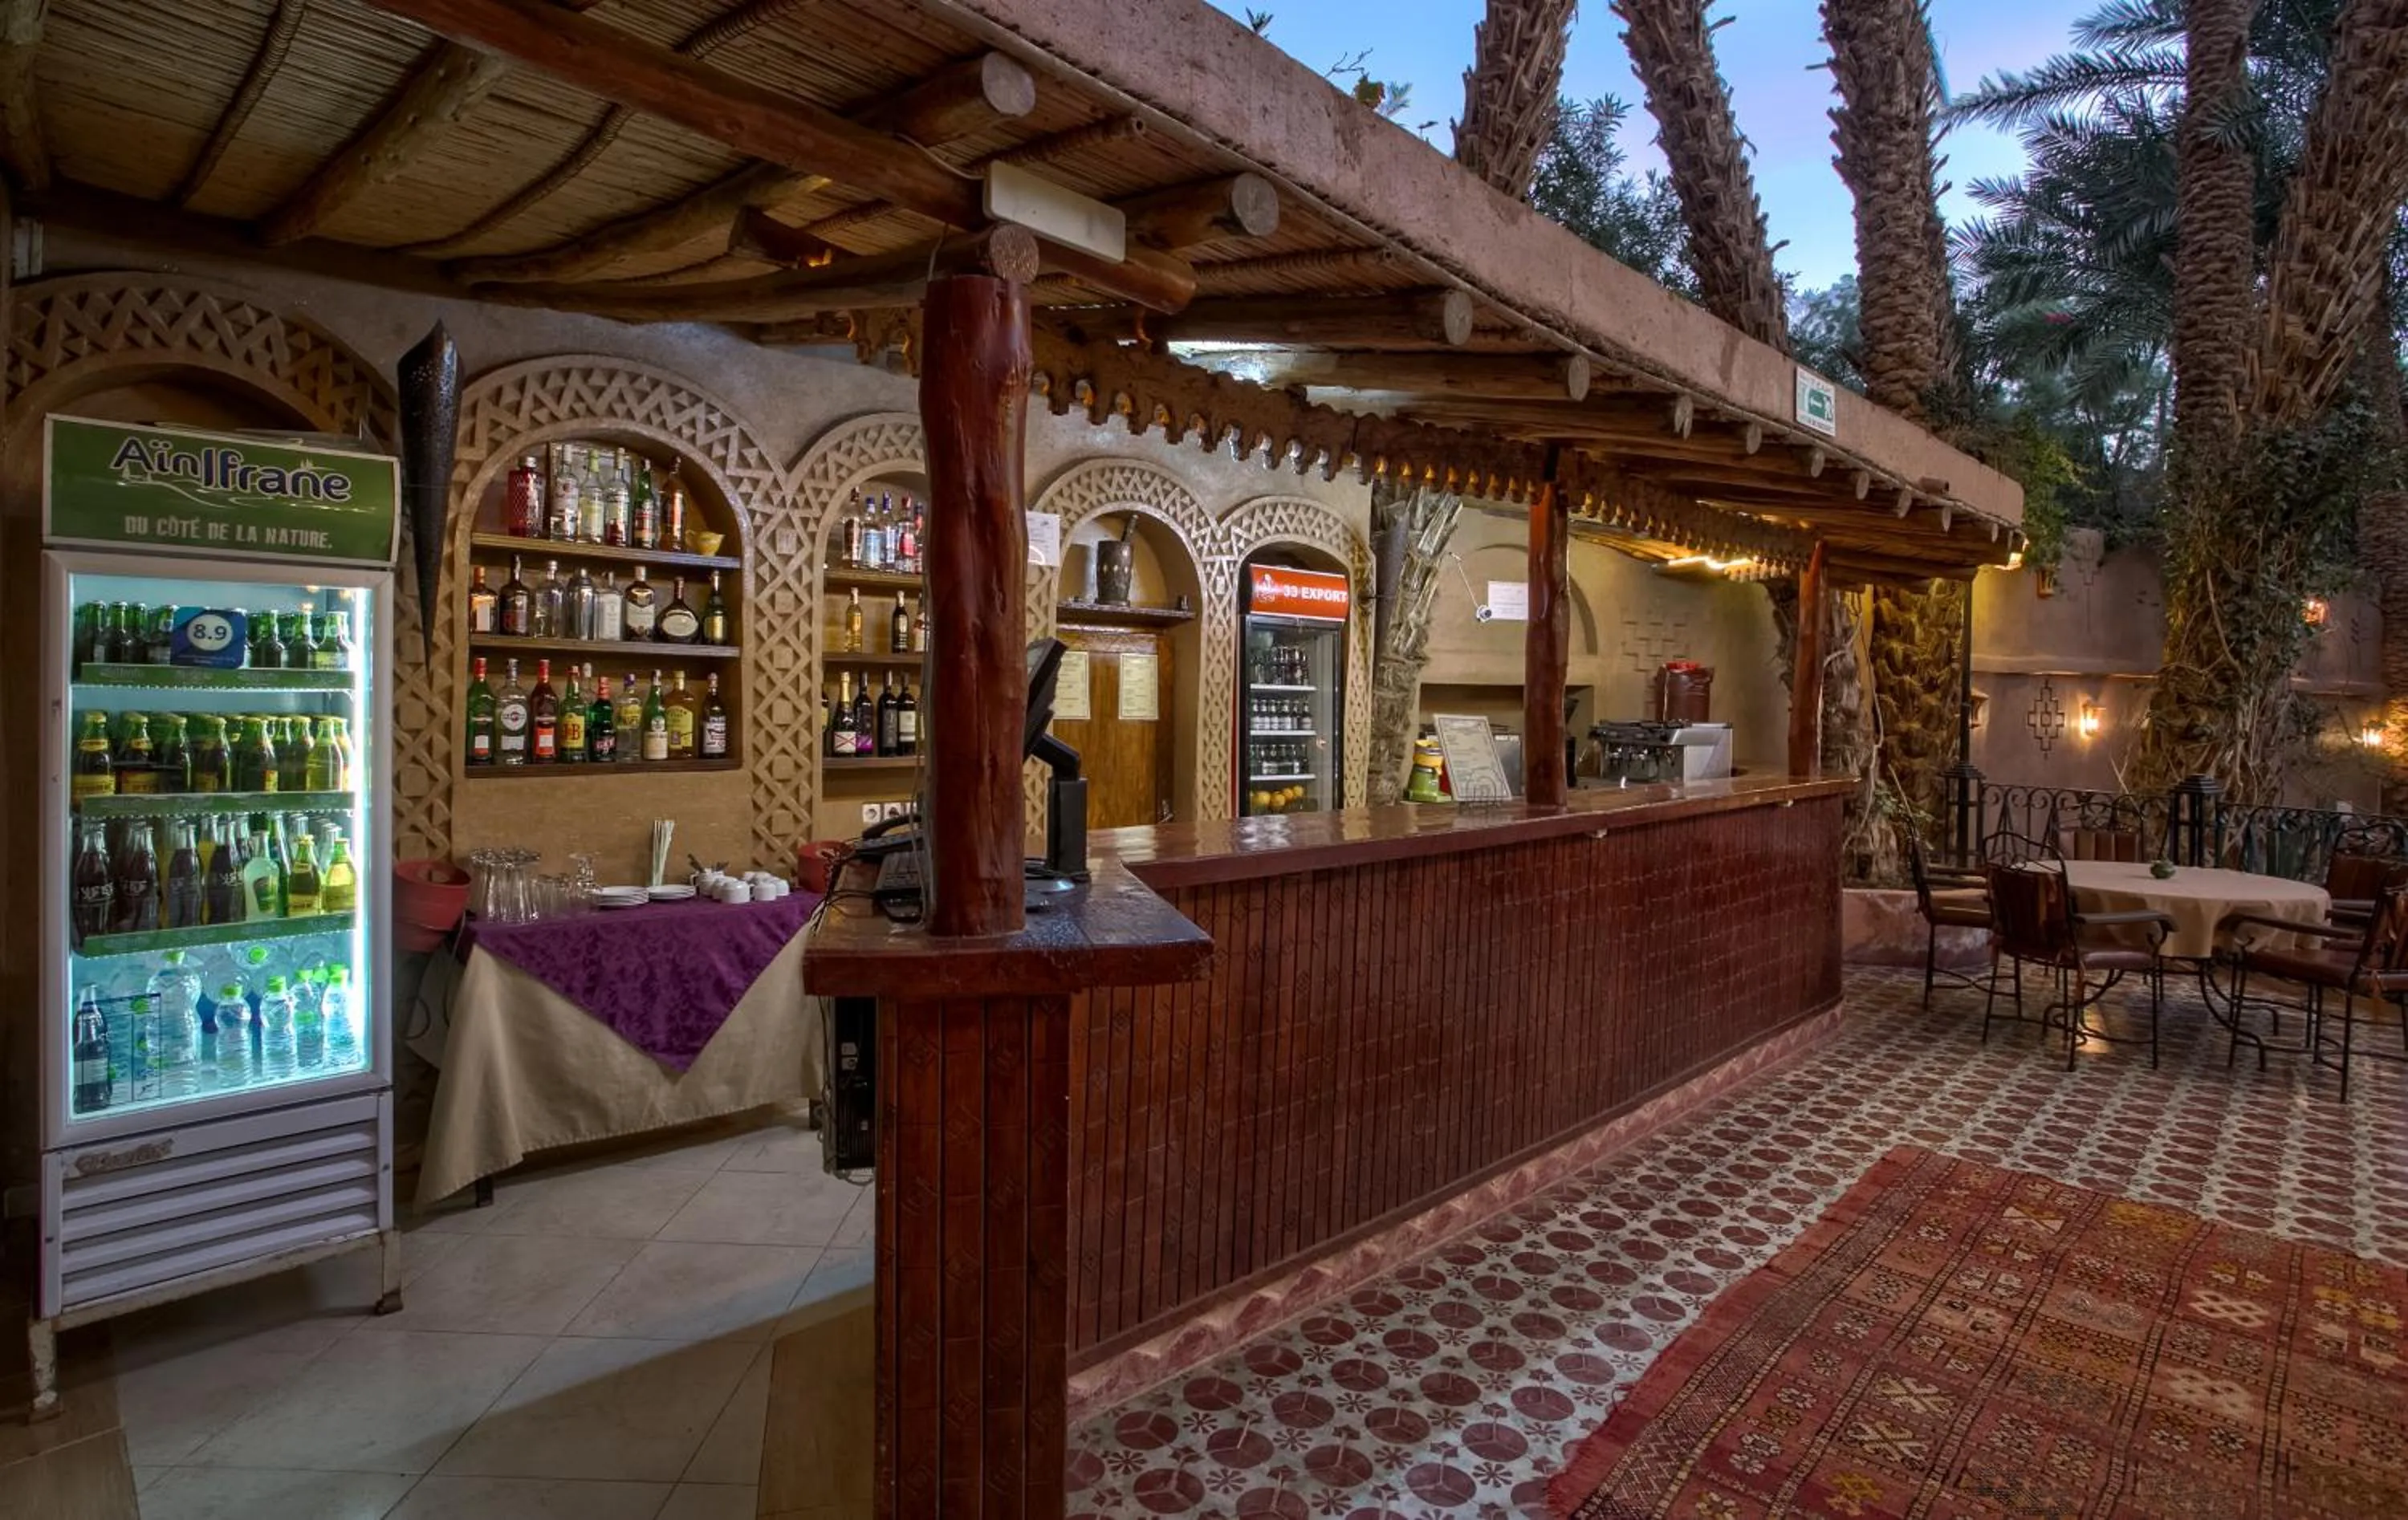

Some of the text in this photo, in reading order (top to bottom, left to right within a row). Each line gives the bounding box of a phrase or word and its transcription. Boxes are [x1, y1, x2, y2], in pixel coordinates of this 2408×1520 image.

[124, 514, 148, 536] DU
[157, 516, 200, 539] CÔTÉ
[208, 522, 228, 541] DE
[236, 525, 258, 543] LA
[1300, 587, 1348, 603] EXPORT
[193, 624, 227, 641] 8.9
